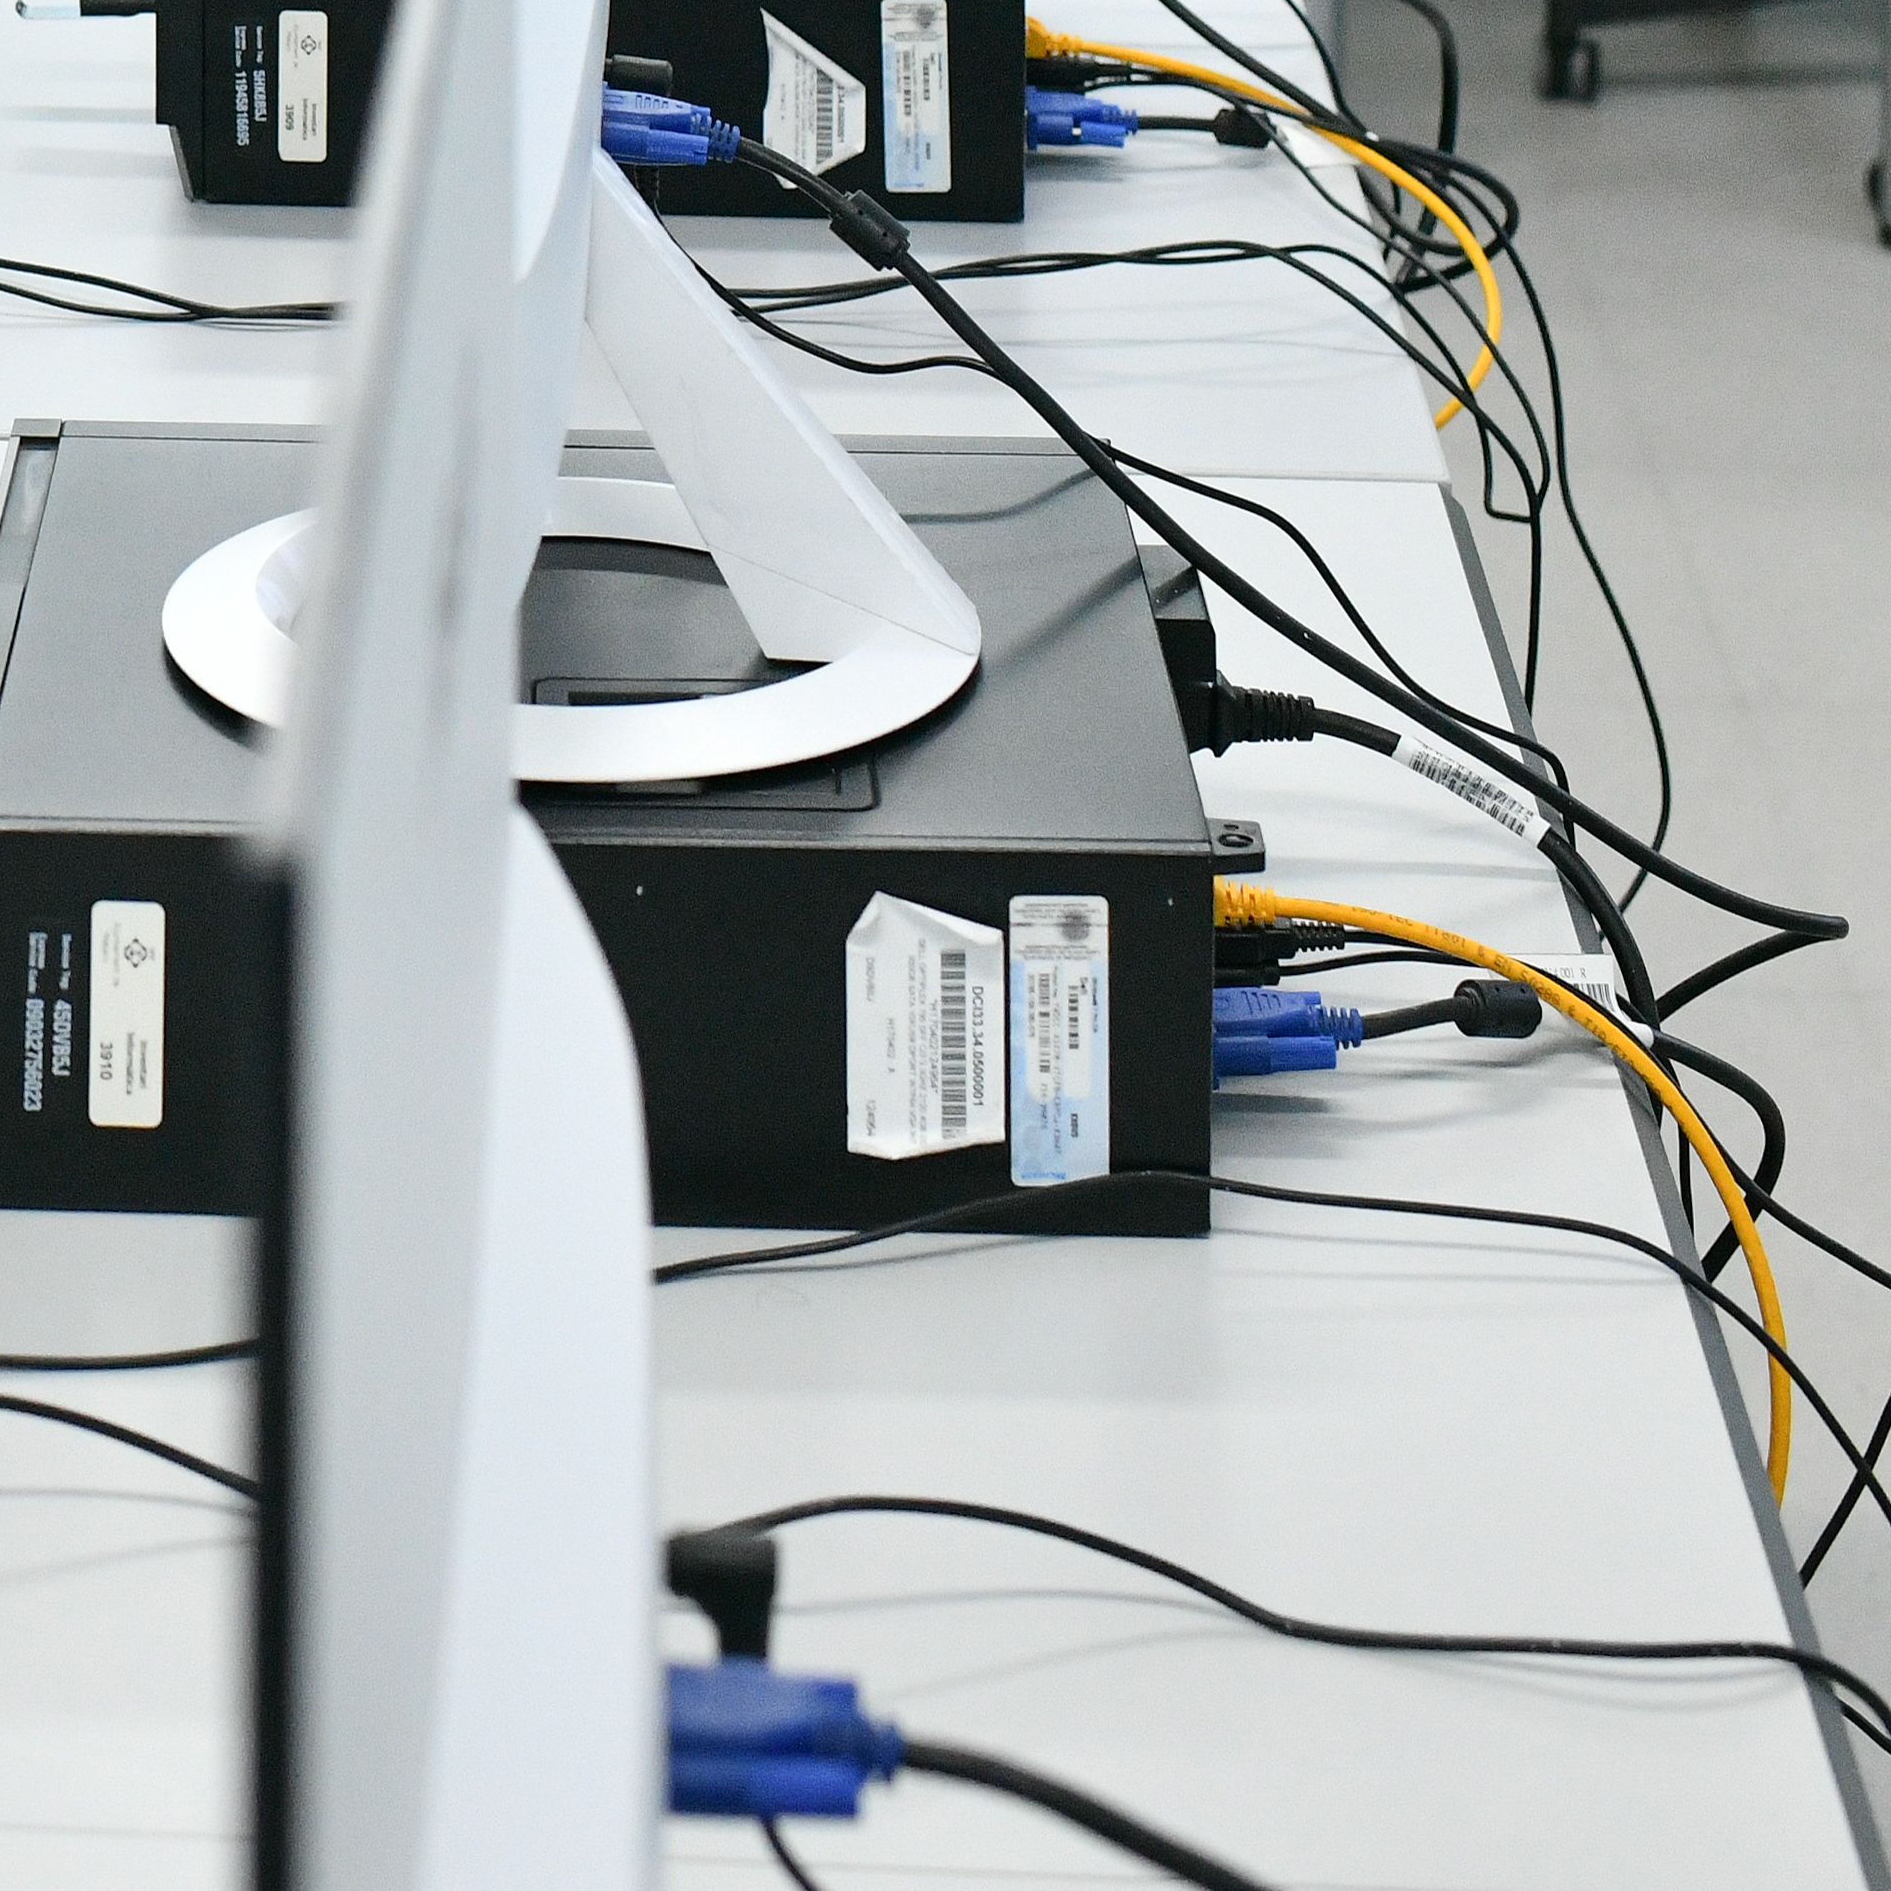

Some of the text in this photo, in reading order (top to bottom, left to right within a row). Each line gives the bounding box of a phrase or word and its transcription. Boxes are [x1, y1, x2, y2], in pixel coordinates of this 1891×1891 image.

[285, 105, 294, 131] 3909
[23, 998, 44, 1111] 09032756023
[100, 1042, 113, 1080] 3910
[971, 986, 984, 1107] DCI33.34.0500001
